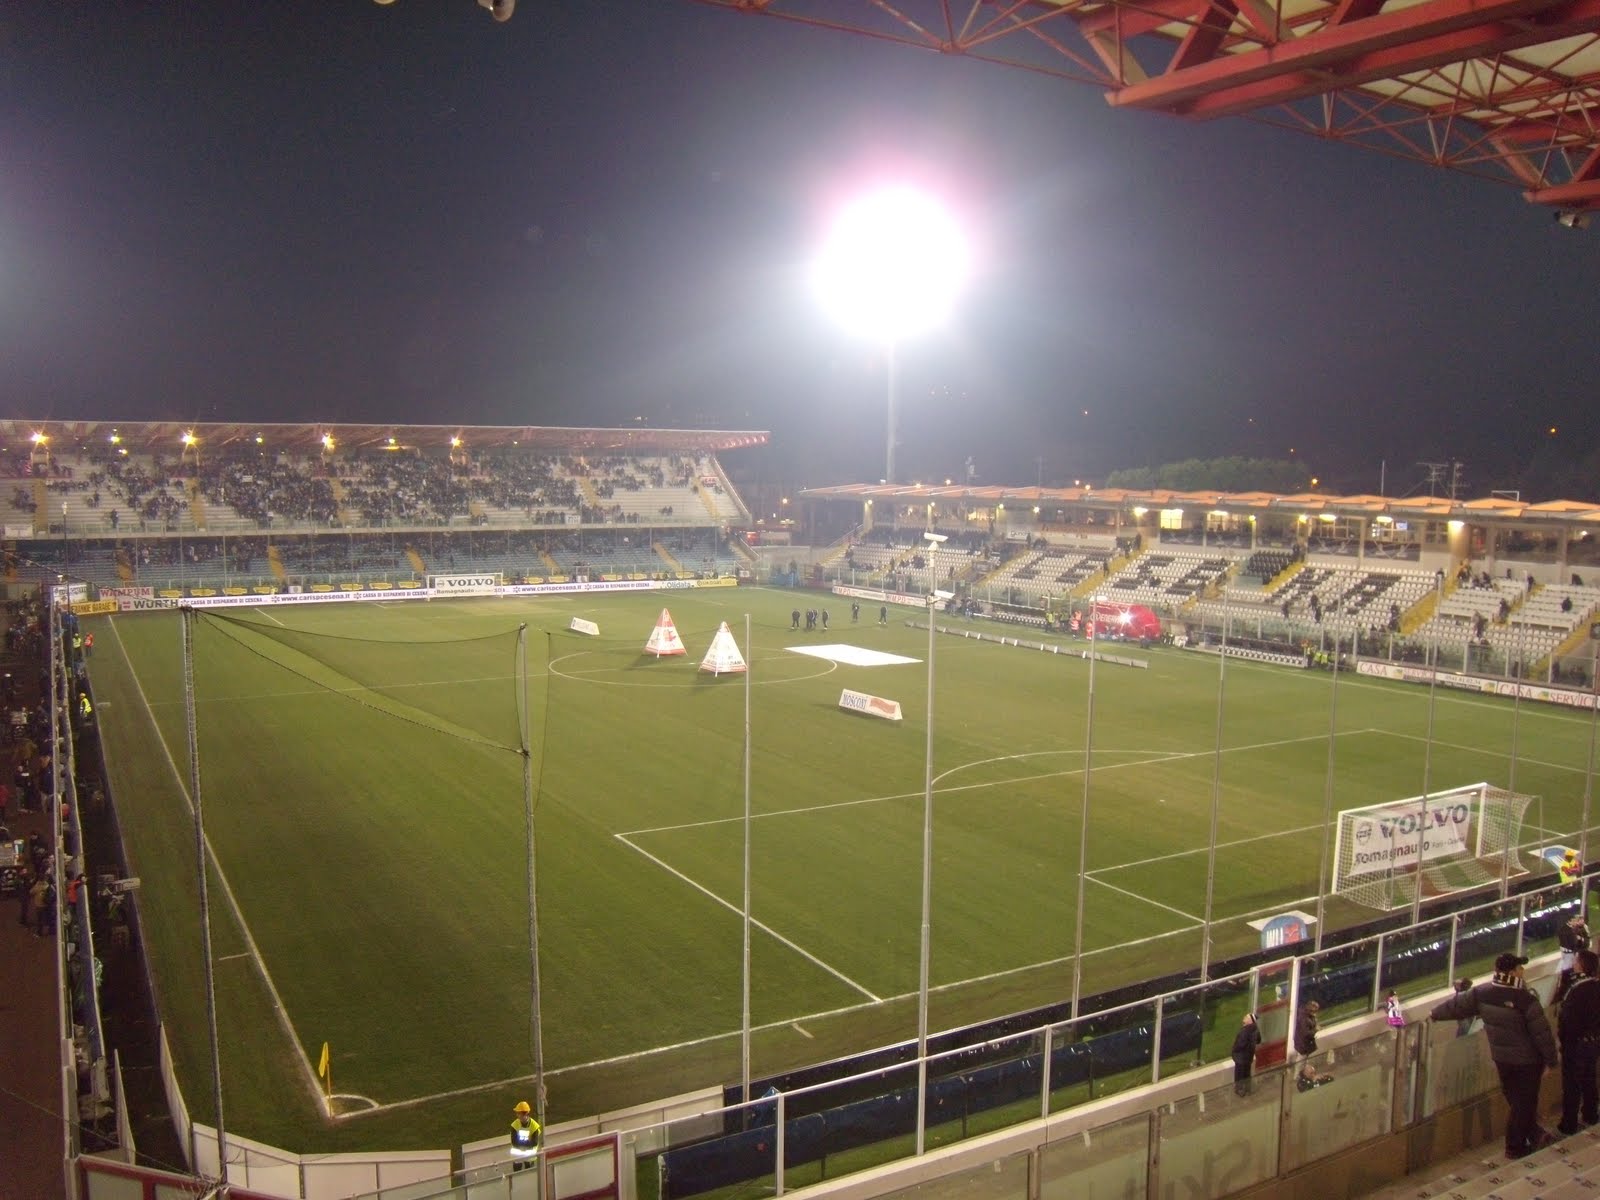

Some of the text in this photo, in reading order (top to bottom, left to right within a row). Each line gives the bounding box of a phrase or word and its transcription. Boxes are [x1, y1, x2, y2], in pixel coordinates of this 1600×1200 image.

[447, 579, 494, 587] VOLVO
[100, 587, 151, 598] WAMPUM
[1360, 663, 1388, 676] CASA
[1500, 683, 1533, 699] CASA
[1380, 804, 1468, 838] VOLVO
